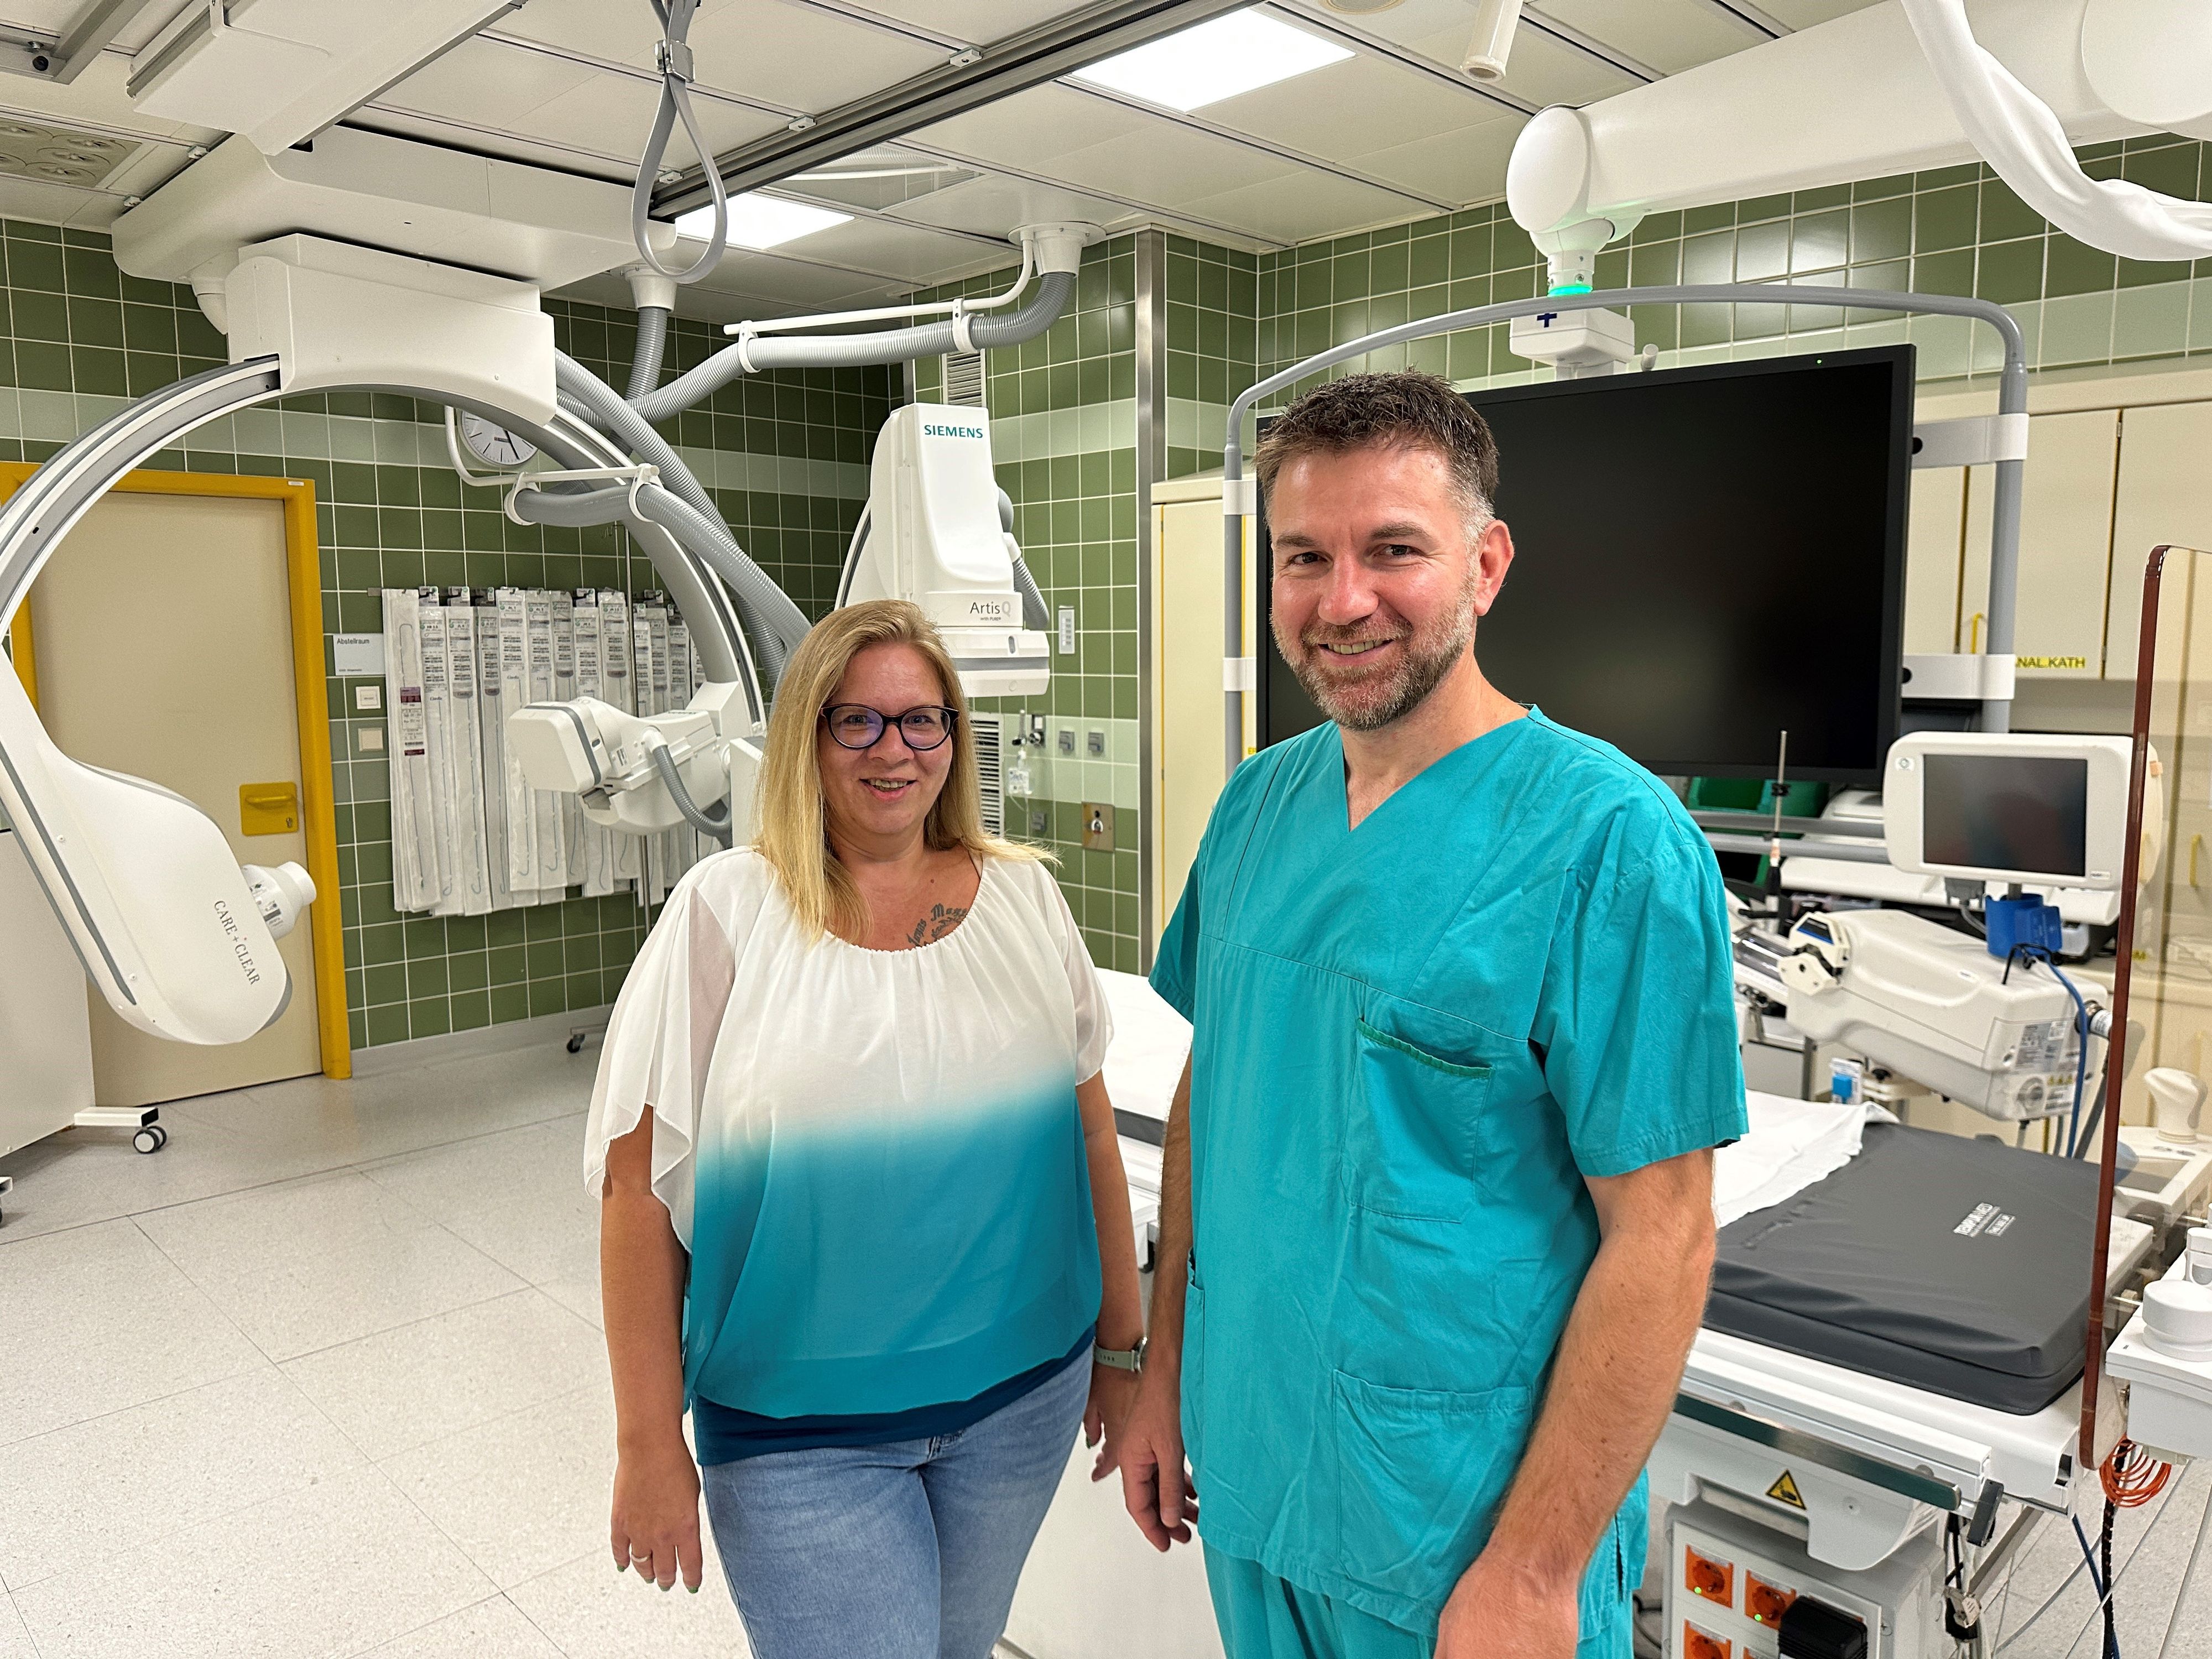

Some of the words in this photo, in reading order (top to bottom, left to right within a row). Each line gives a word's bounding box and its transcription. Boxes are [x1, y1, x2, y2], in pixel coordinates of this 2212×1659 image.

[924, 425, 983, 439] SIEMENS
[2048, 656, 2085, 668] KATH
[214, 900, 238, 935] CARE
[234, 943, 260, 985] CLEAR
